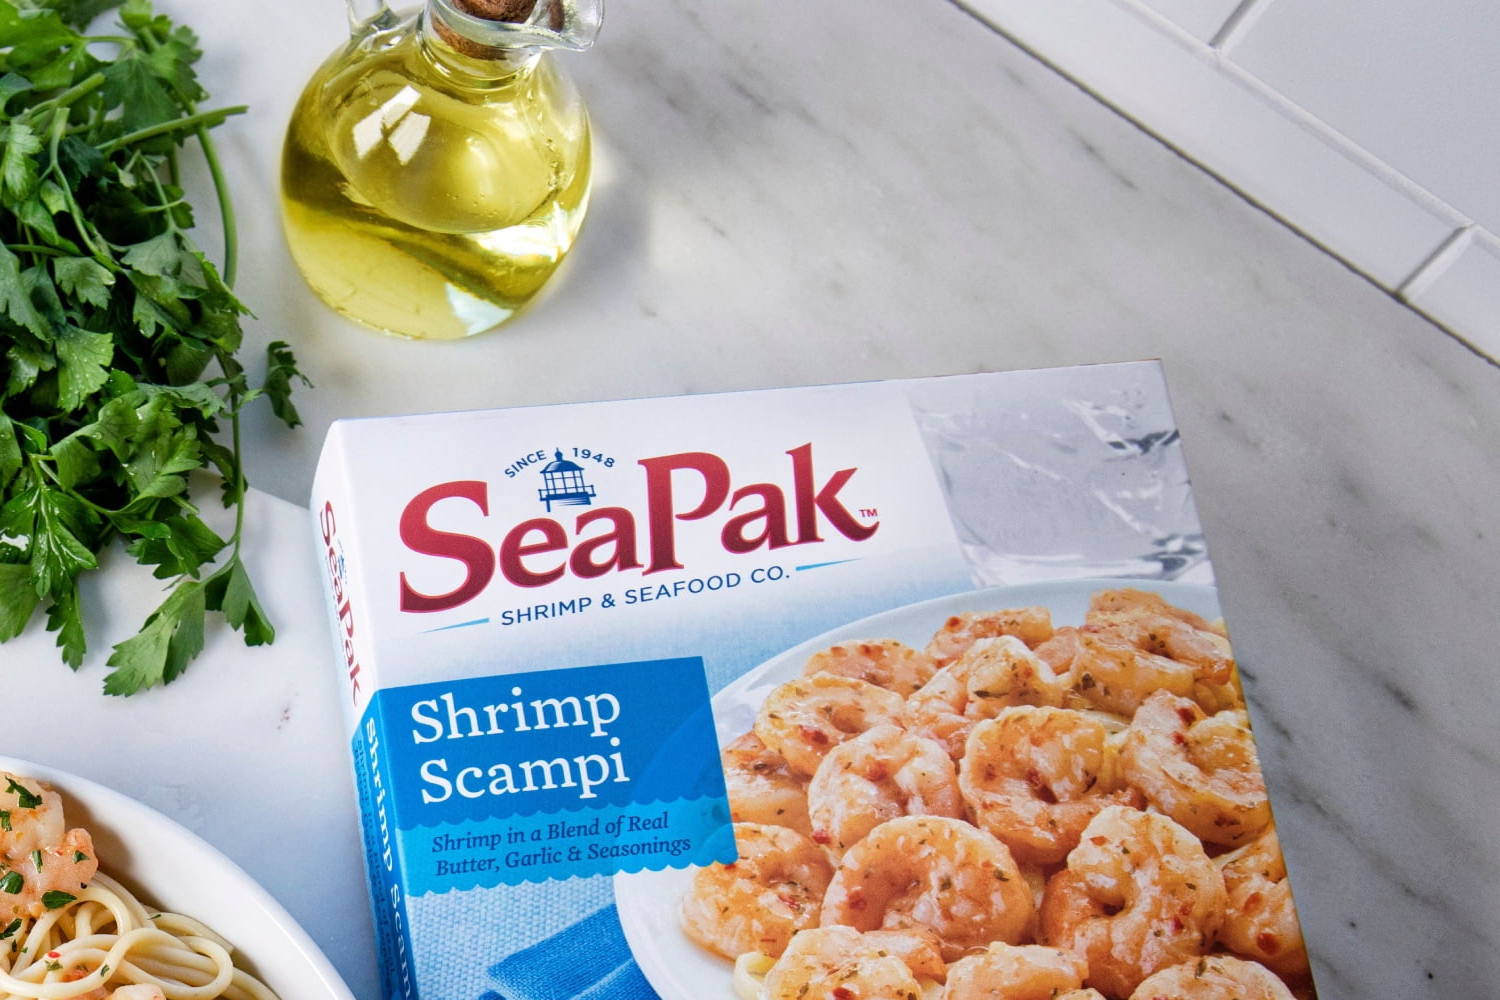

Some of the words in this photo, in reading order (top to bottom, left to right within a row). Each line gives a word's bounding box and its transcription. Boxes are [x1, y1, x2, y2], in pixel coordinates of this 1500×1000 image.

[504, 449, 547, 478] SINCE
[572, 447, 615, 468] 1948
[399, 442, 880, 614] SeaPak
[320, 500, 361, 708] SeaPak
[501, 597, 593, 626] SHRIMP
[601, 593, 616, 609] &
[624, 573, 741, 604] SEAFOOD
[750, 565, 790, 584] CO.
[411, 686, 621, 744] Shrimp
[366, 717, 393, 872] Shrimp
[420, 737, 630, 804] Scampi
[431, 831, 501, 853] Shrimp
[507, 826, 525, 844] in
[530, 828, 542, 842] a
[547, 818, 600, 840] Blend
[605, 815, 628, 838] of
[627, 811, 669, 832] Real
[435, 856, 500, 876] Butter,
[505, 847, 562, 869] Garlic
[567, 846, 582, 862] &
[587, 836, 691, 860] Seasonings
